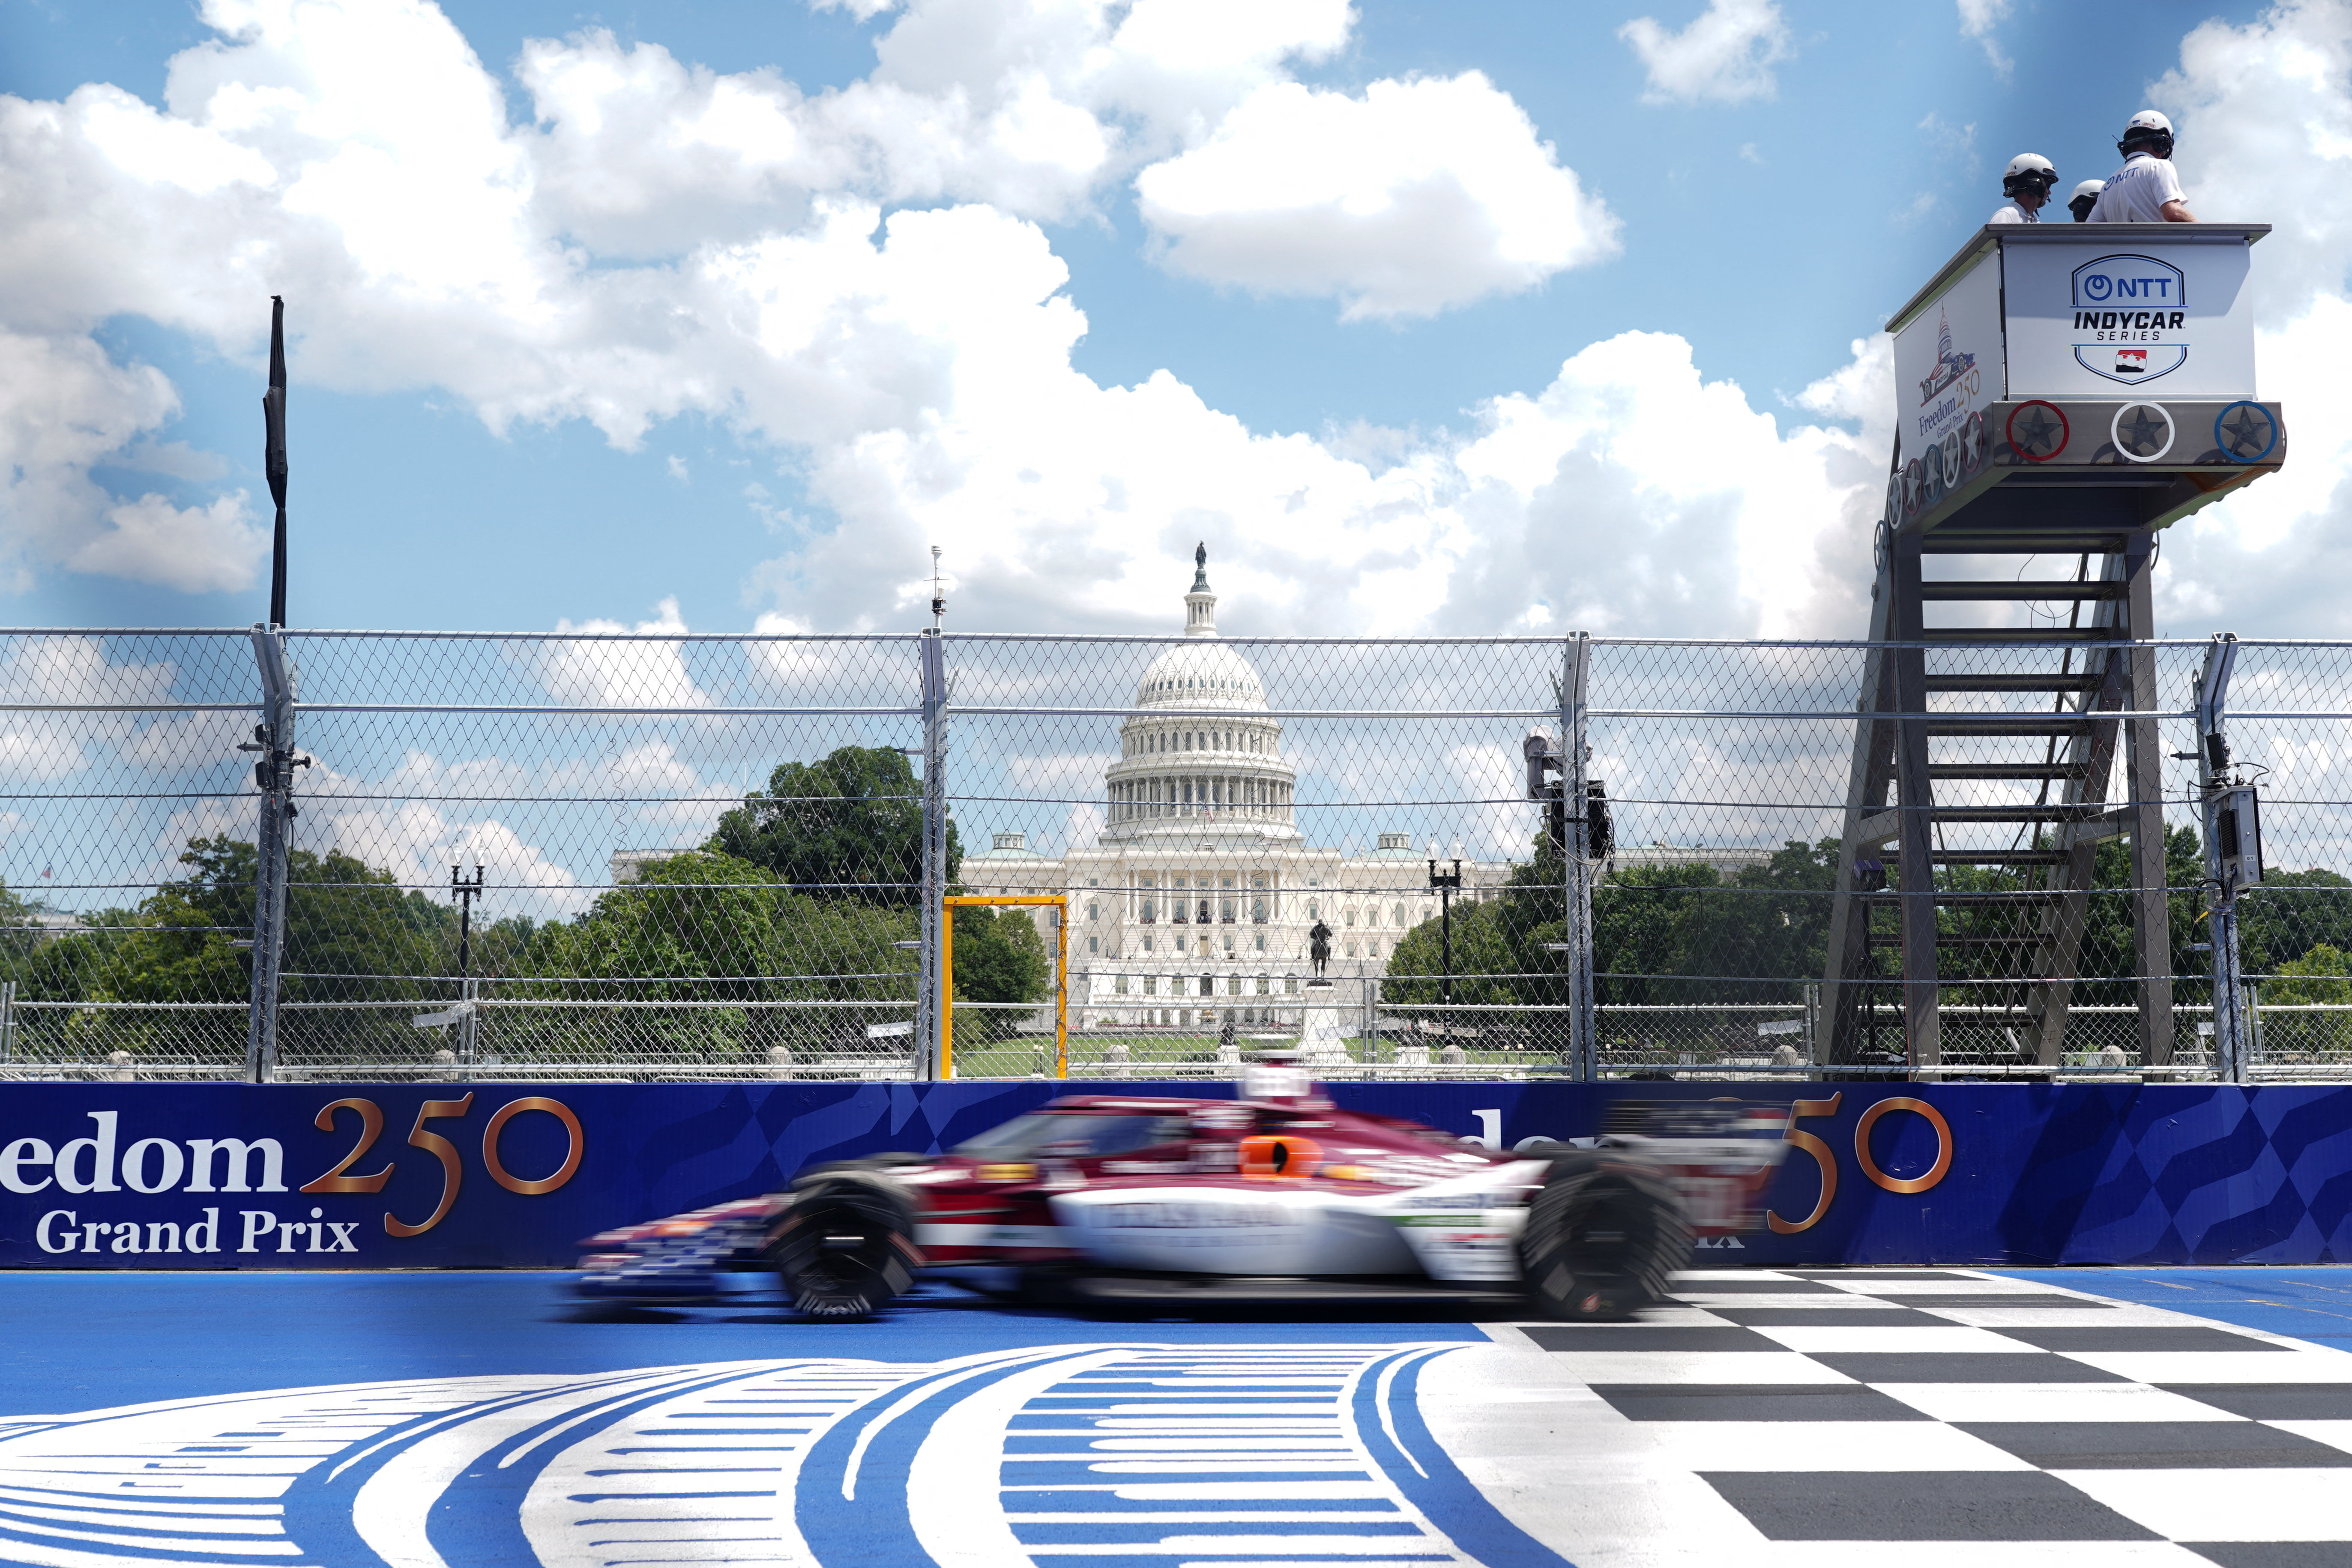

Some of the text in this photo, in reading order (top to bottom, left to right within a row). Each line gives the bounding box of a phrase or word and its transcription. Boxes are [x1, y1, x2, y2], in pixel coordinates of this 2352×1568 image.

[2116, 167, 2139, 183] NTT
[2118, 278, 2172, 297] NTT
[2074, 312, 2184, 329] INDYCAR
[2097, 331, 2160, 341] SERIES
[1918, 369, 1980, 437] Freedom 250
[1937, 412, 1964, 439] Grand Prix
[299, 1092, 584, 1238] 250
[1707, 1091, 1953, 1235] 50
[36, 1206, 359, 1254] Grand Prix
